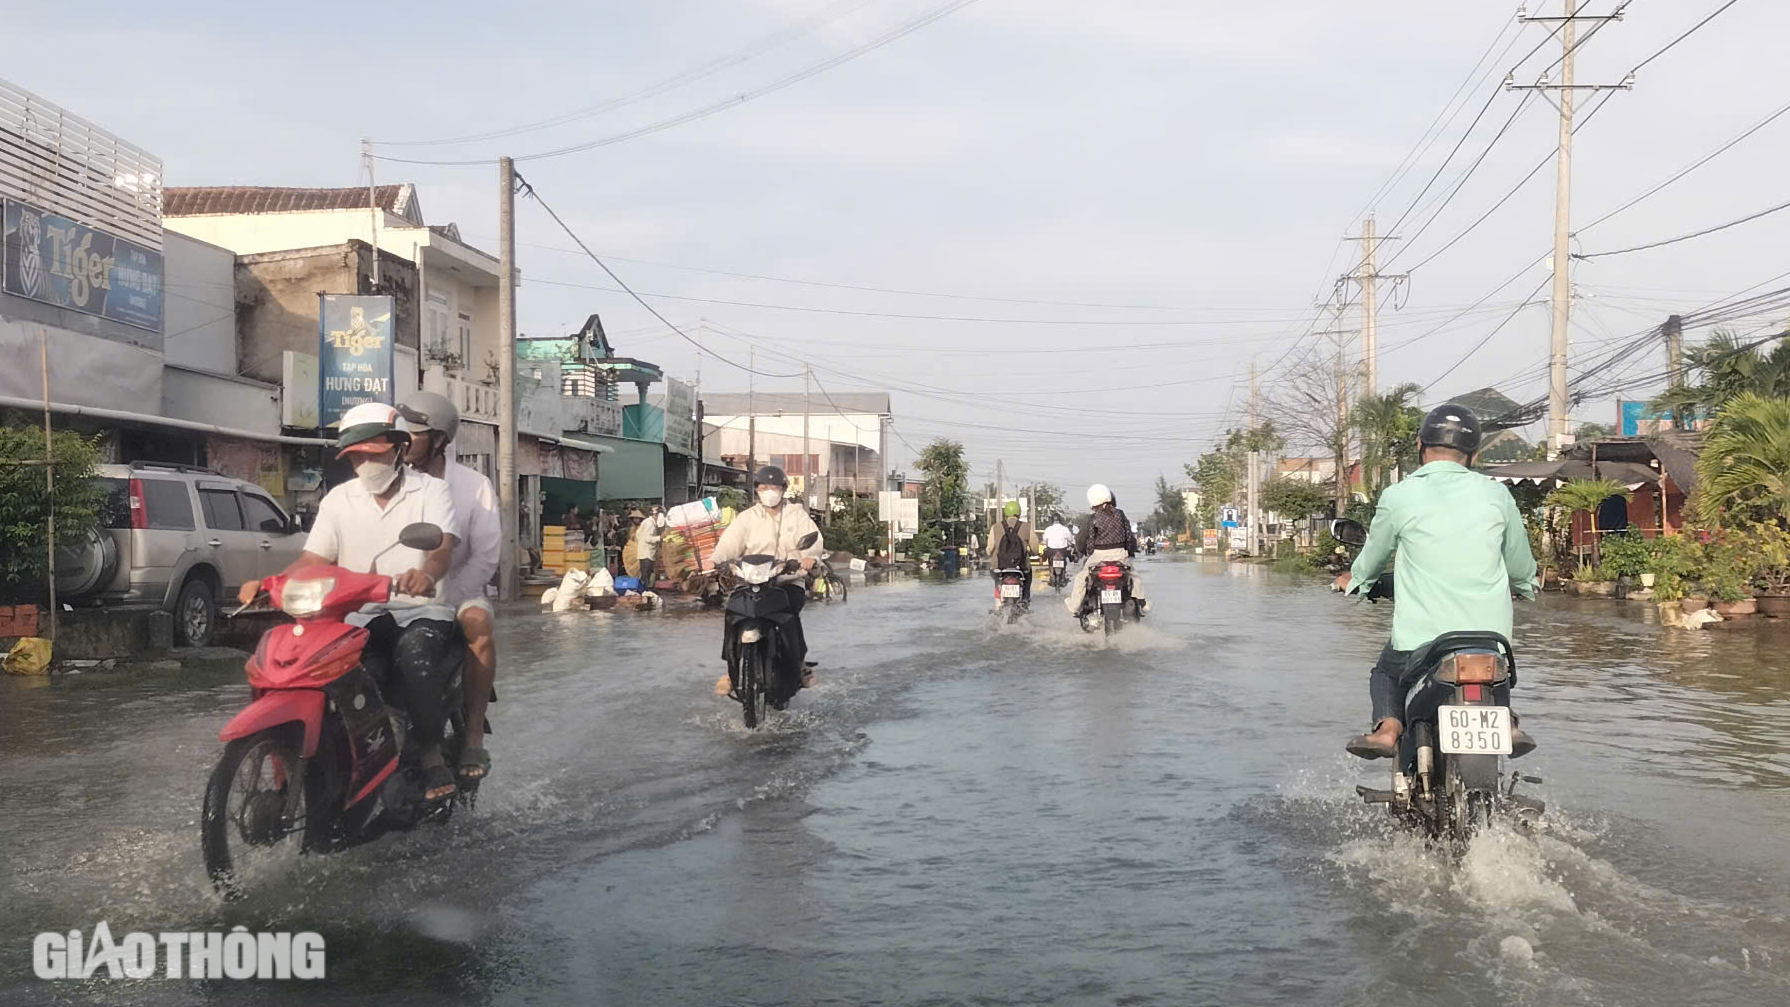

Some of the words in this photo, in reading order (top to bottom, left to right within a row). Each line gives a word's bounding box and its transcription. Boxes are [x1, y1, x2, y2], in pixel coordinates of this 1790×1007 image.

[46, 225, 115, 306] Tiger
[331, 329, 384, 356] Tiger
[364, 377, 389, 395] ĐẠT
[1450, 710, 1499, 728] 60-M2
[1451, 731, 1500, 750] 8350
